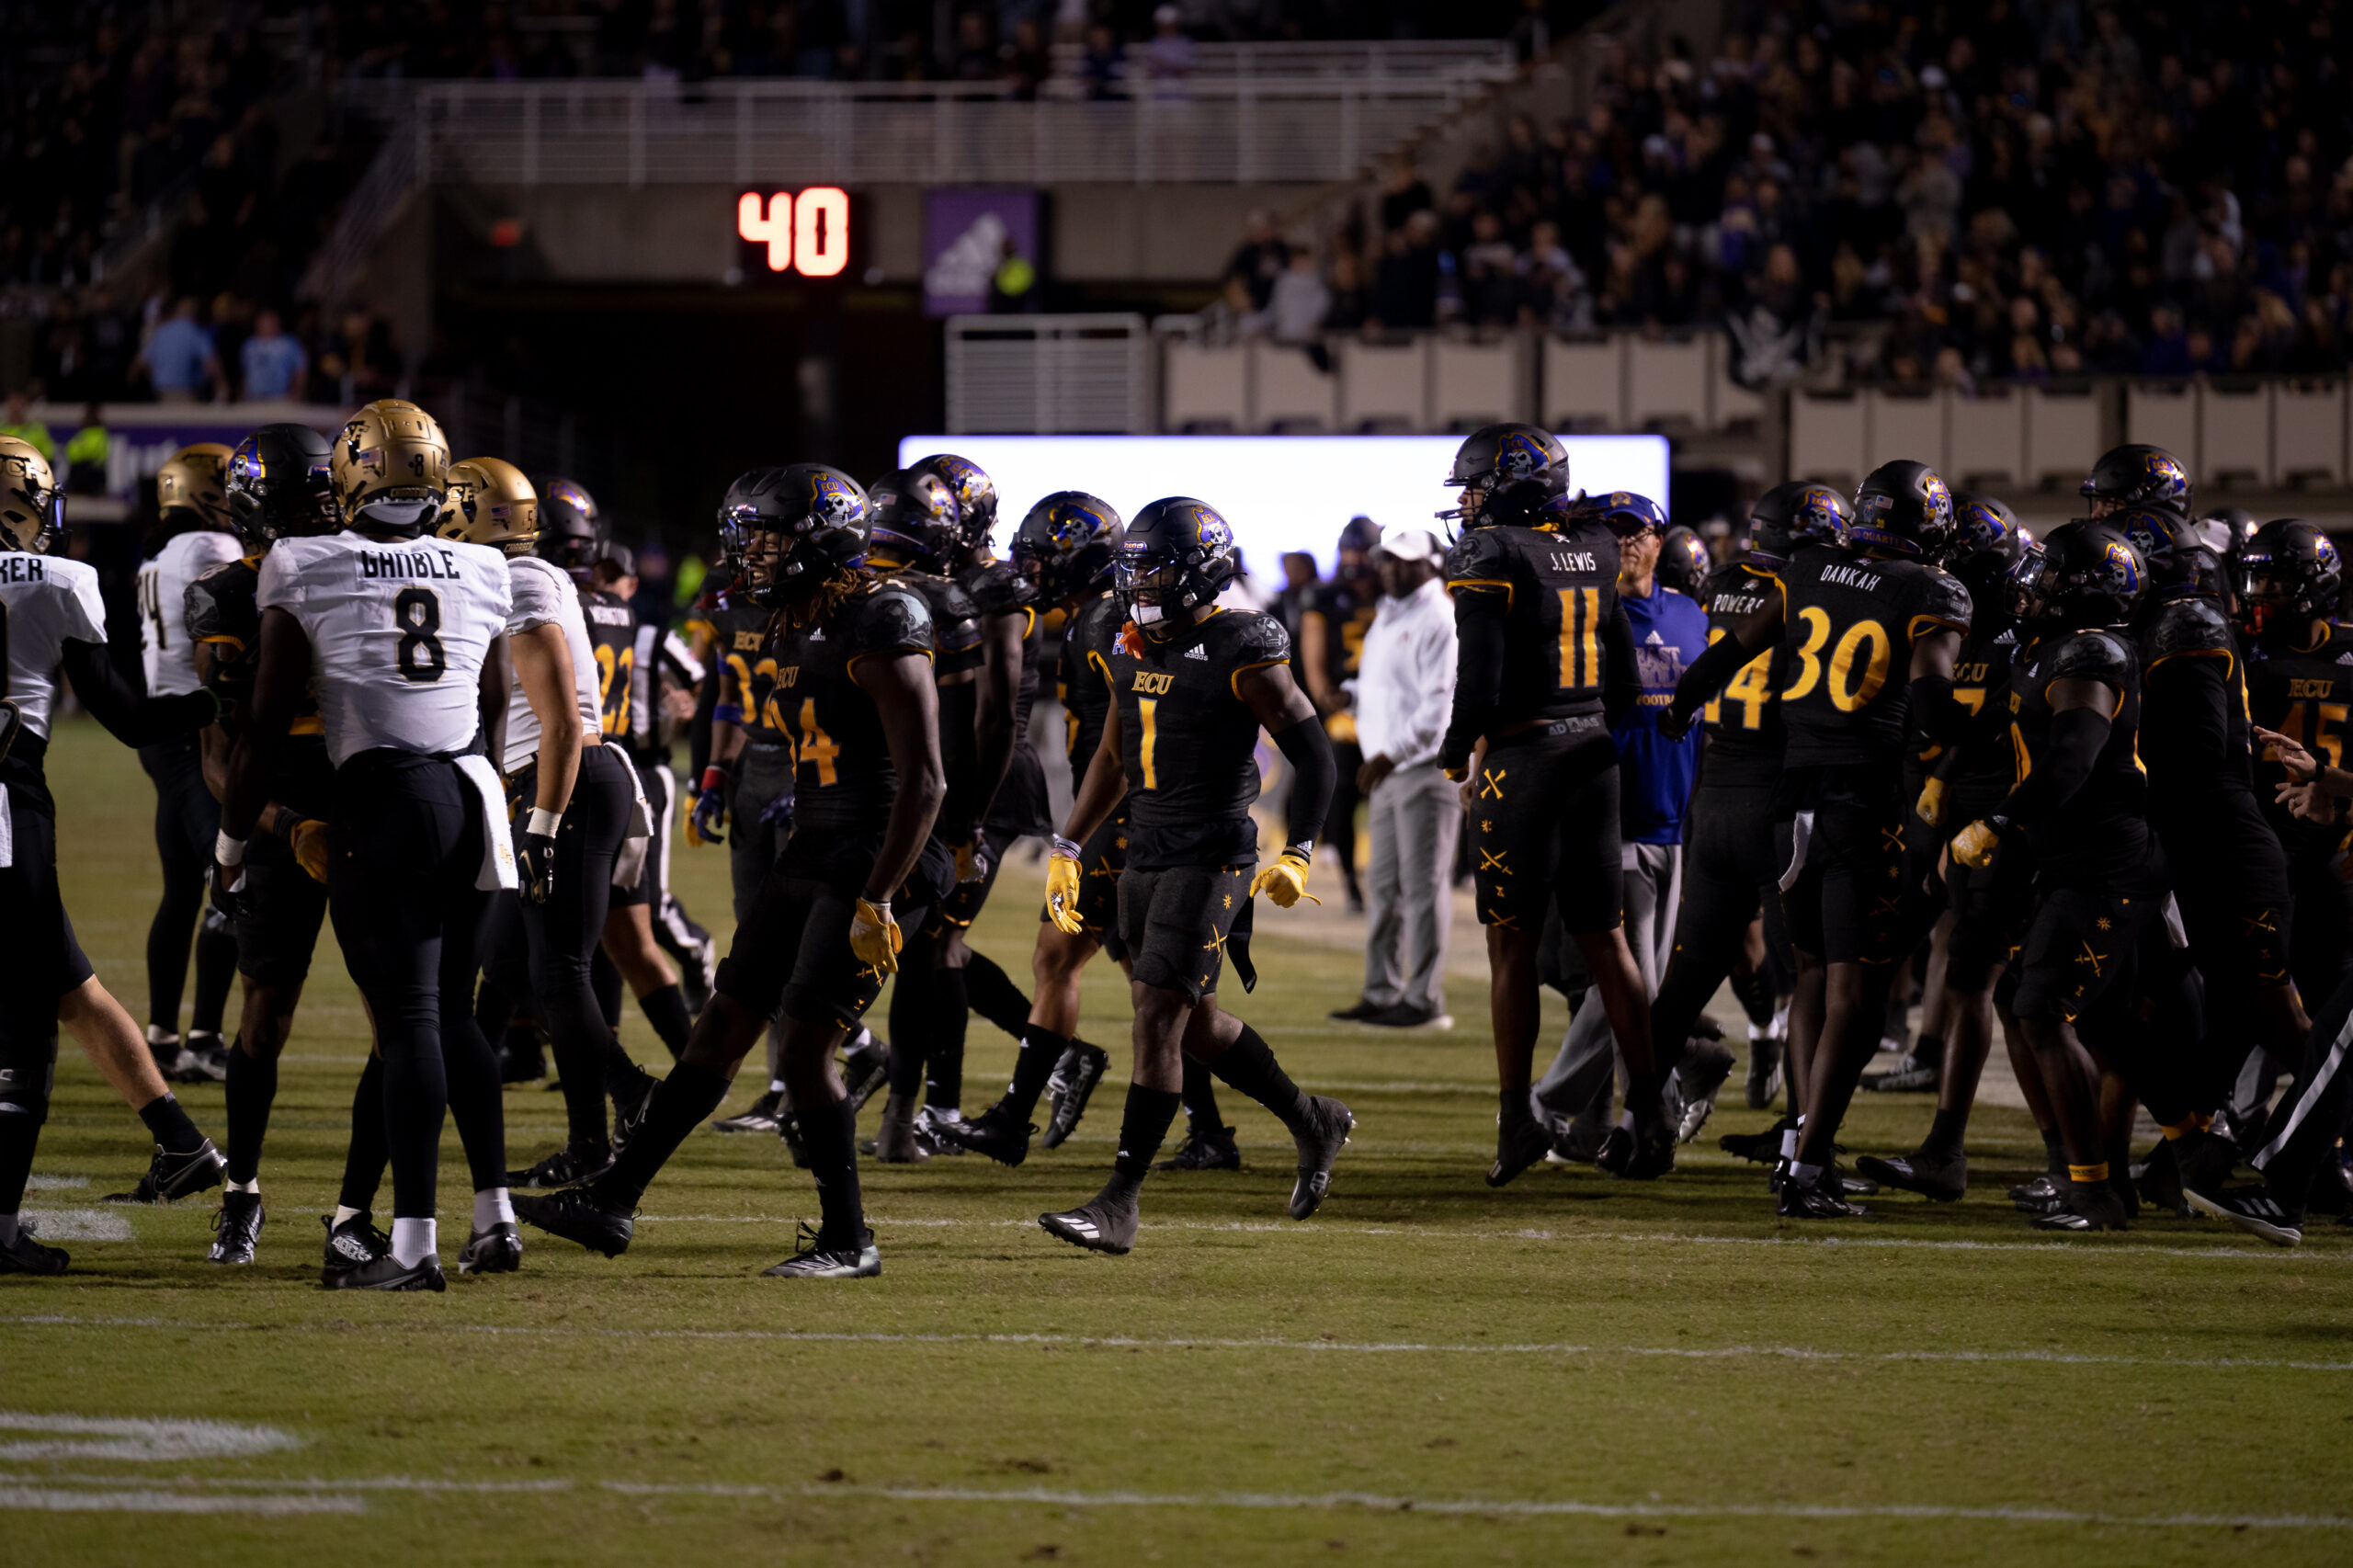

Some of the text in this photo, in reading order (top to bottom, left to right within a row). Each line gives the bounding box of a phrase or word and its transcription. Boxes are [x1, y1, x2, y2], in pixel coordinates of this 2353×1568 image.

[738, 187, 849, 277] 40
[415, 454, 424, 477] 8
[821, 481, 839, 492] ECU
[1820, 564, 1882, 592] DANKAH
[395, 585, 445, 684] 8
[1555, 585, 1600, 689] 11
[1184, 651, 1210, 662] adidas
[1780, 605, 1893, 714] 30
[1131, 670, 1176, 696] ECU
[2287, 677, 2336, 699] ECU
[1138, 696, 1159, 790] 1
